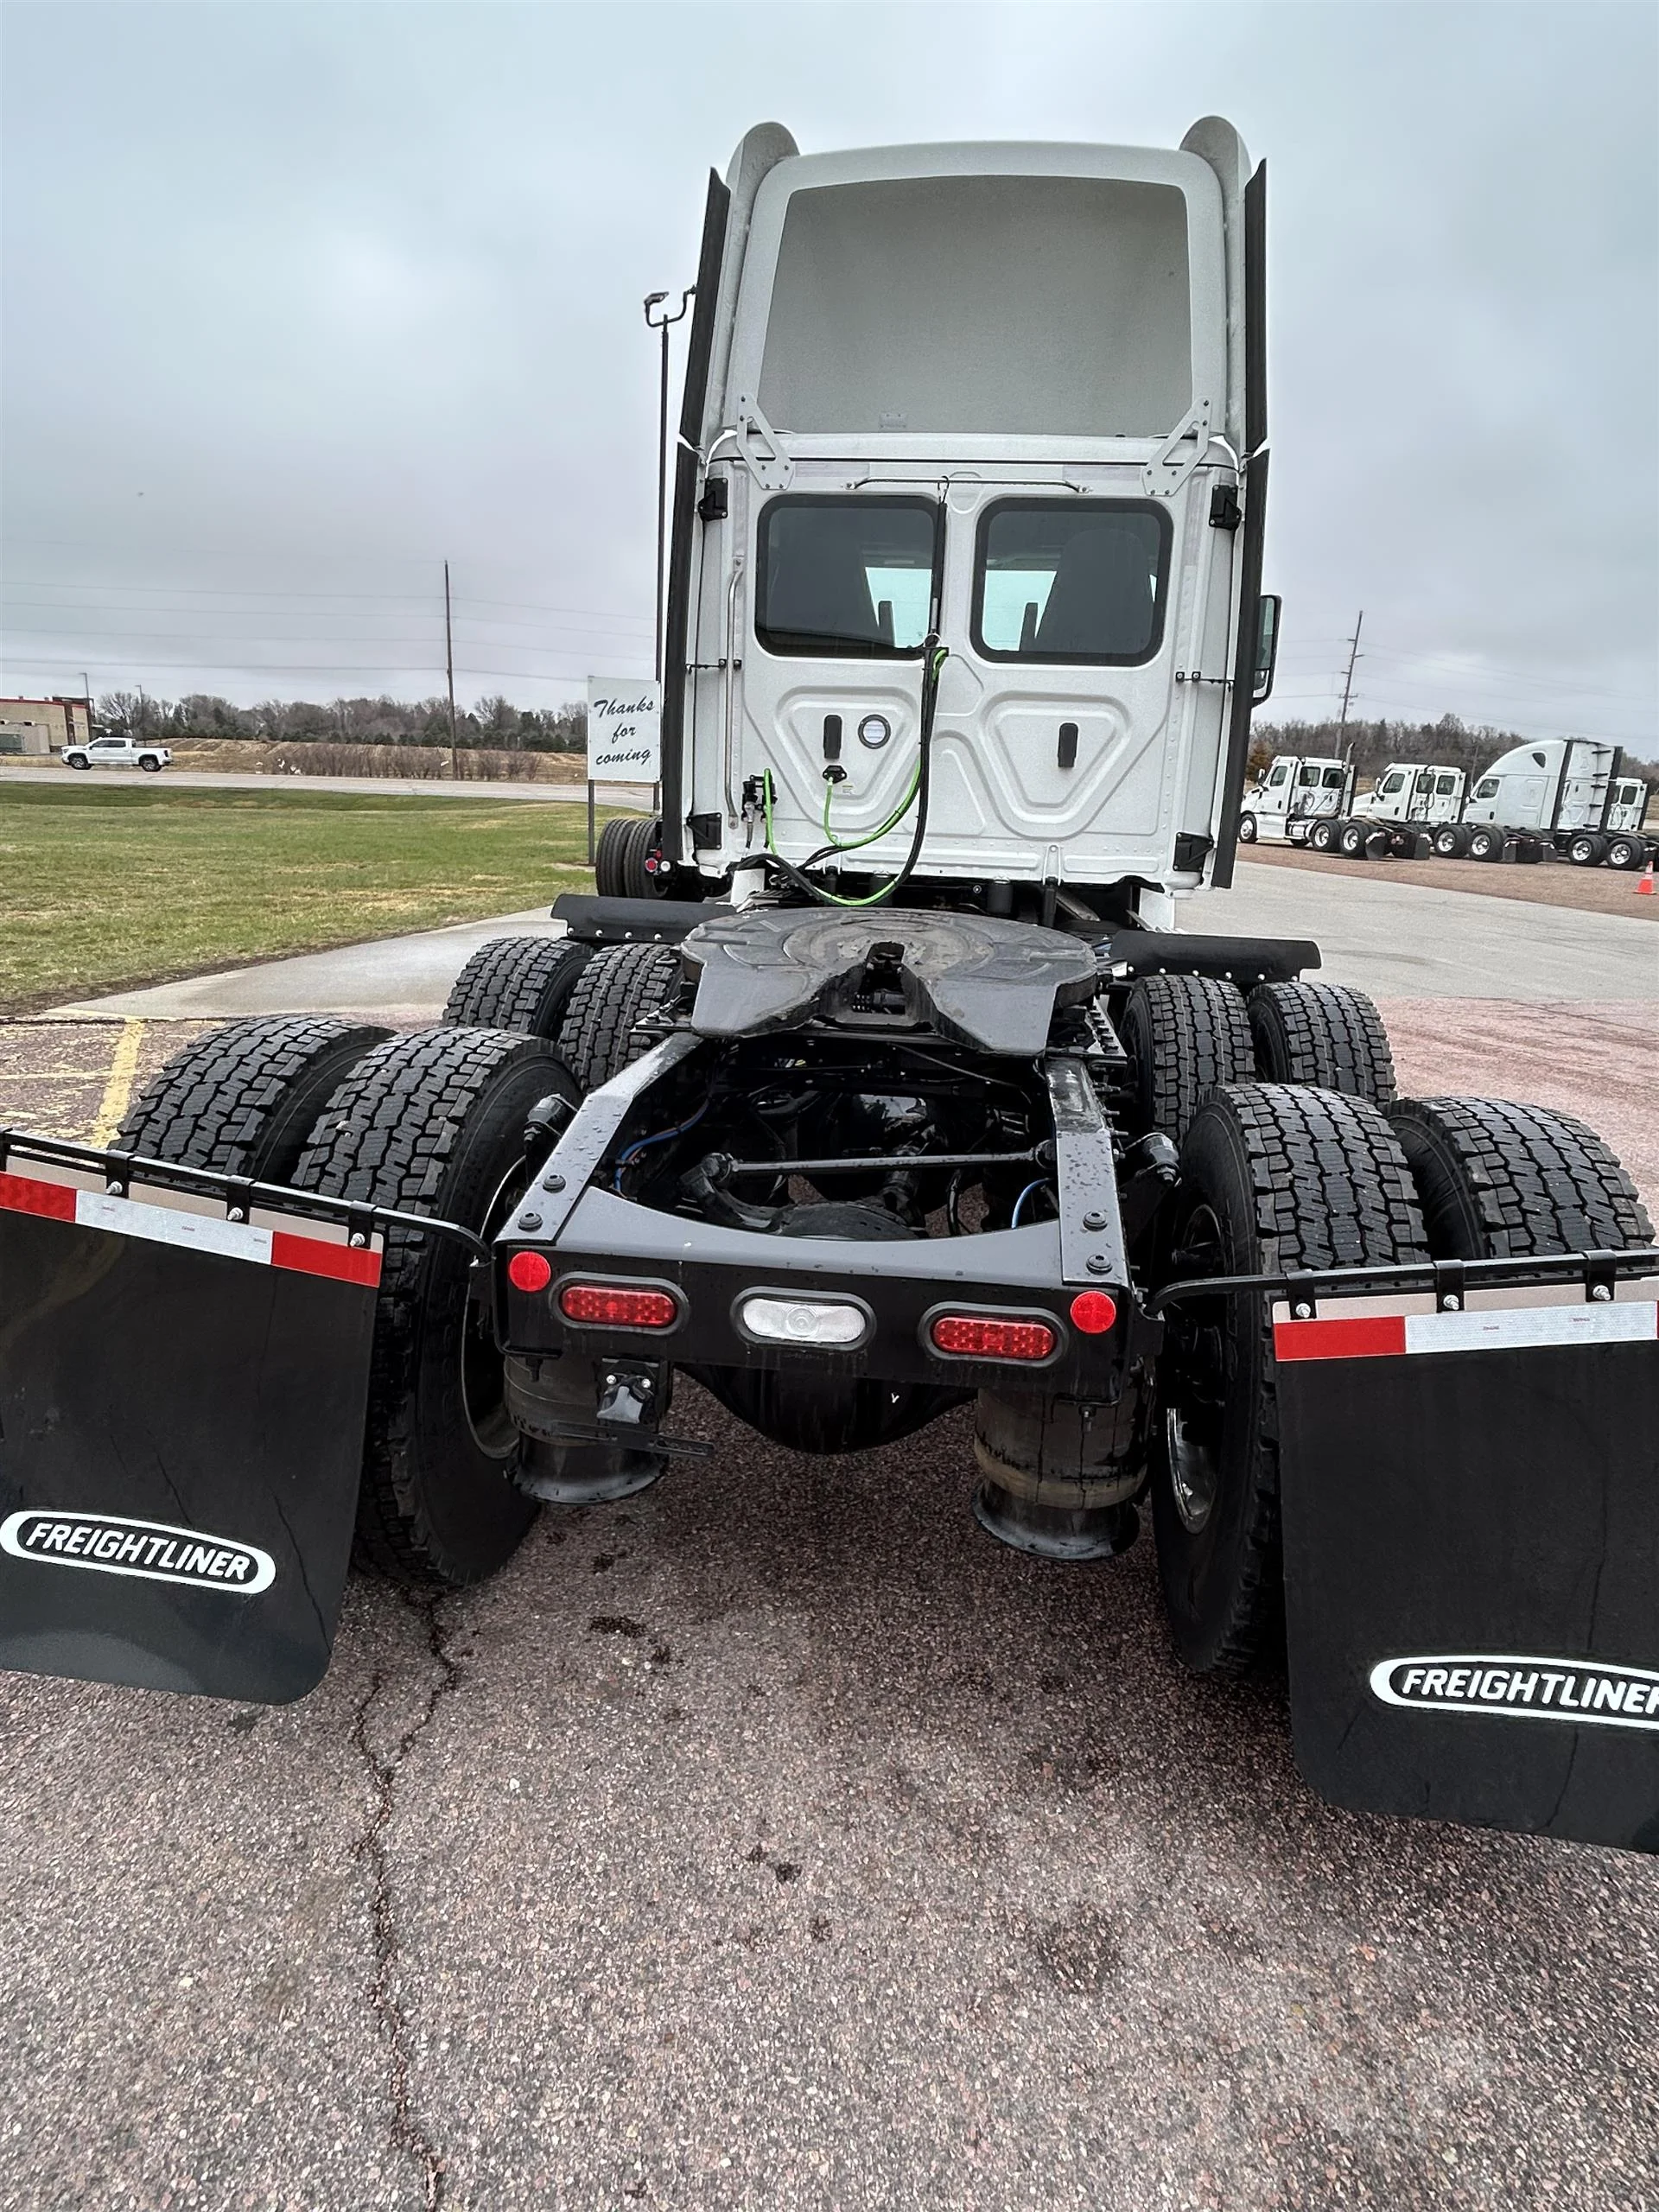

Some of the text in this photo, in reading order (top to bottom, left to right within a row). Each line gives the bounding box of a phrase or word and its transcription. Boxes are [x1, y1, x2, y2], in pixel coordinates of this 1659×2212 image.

[594, 696, 655, 718] Thanks
[612, 722, 636, 744] for
[596, 748, 652, 766] coming
[25, 1522, 251, 1580] FREIGHTLINER
